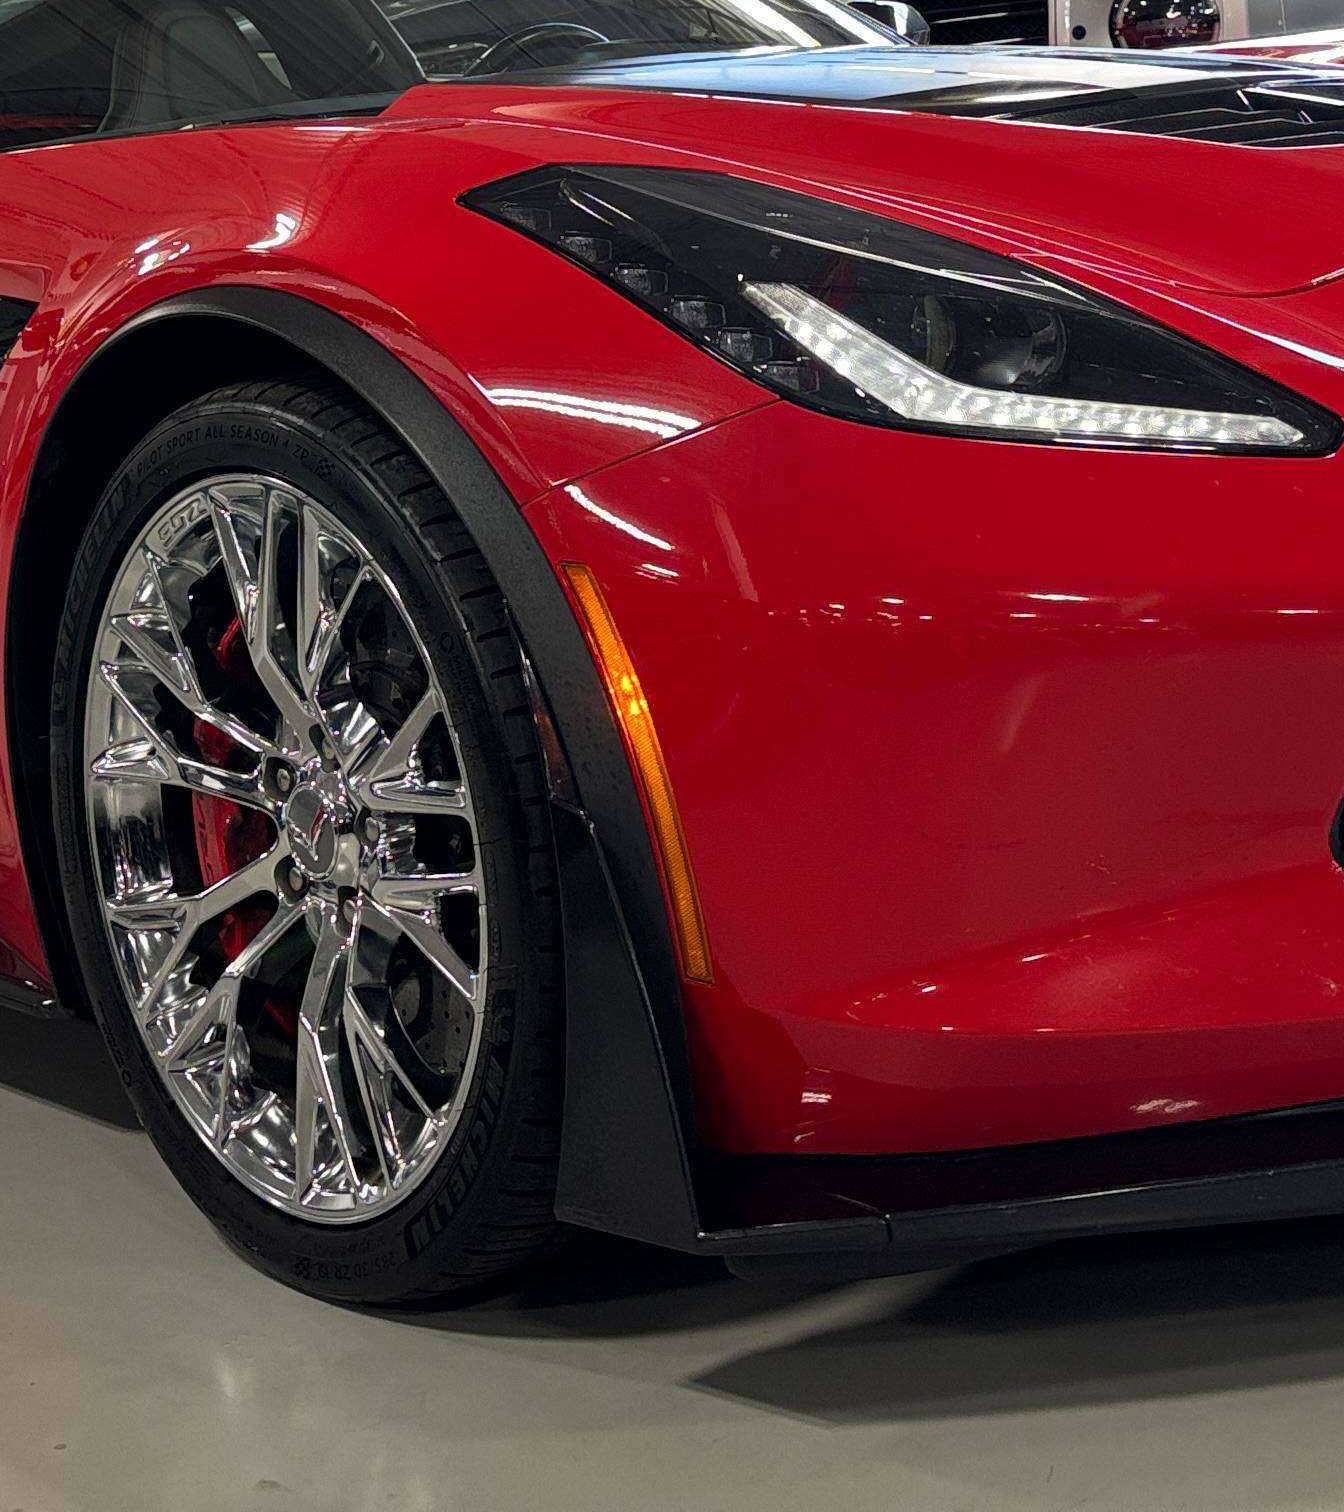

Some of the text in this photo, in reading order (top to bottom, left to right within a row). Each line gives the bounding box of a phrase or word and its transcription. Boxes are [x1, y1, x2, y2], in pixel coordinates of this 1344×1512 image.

[166, 427, 201, 455] SPORT
[204, 423, 226, 440] ALL
[229, 423, 280, 448] SEASON
